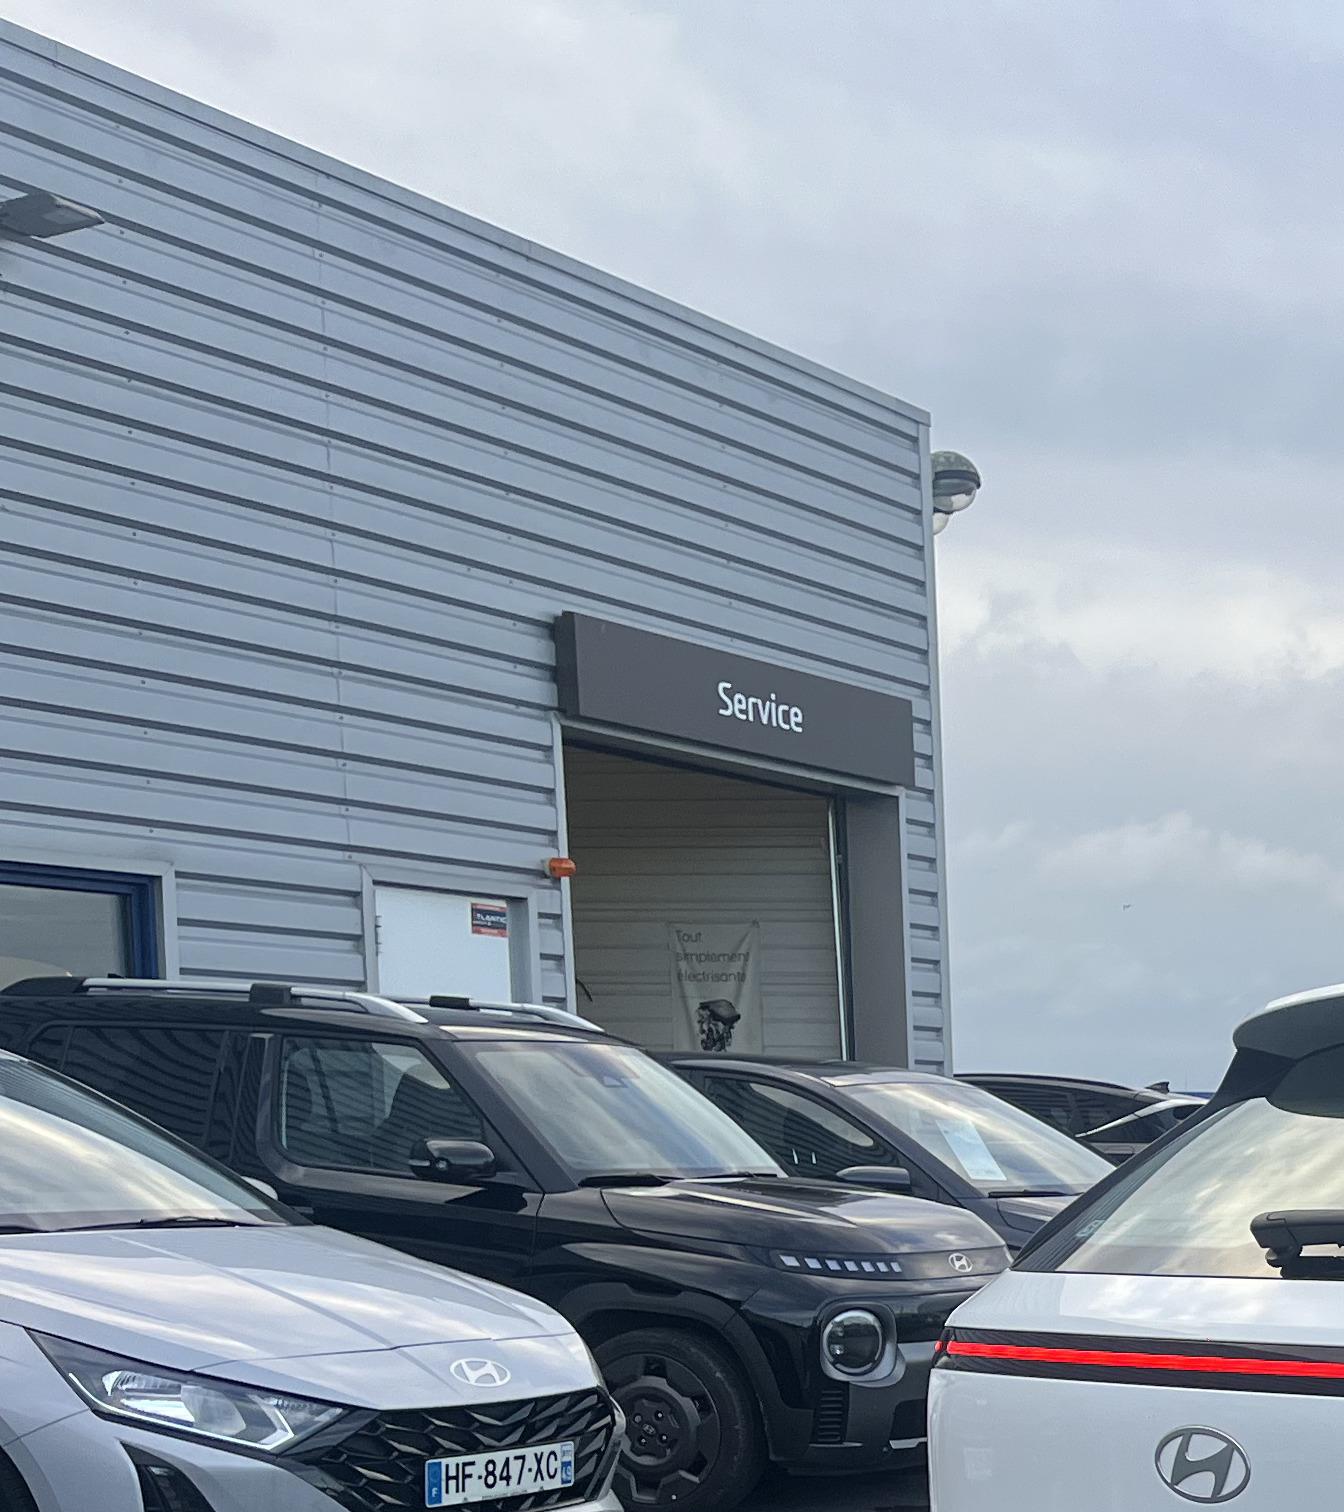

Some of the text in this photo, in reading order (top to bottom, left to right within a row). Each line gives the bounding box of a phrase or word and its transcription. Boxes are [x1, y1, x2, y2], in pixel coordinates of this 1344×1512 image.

[718, 682, 803, 733] Service
[676, 930, 703, 943] Tout
[445, 1450, 558, 1495] HF-847-XC
